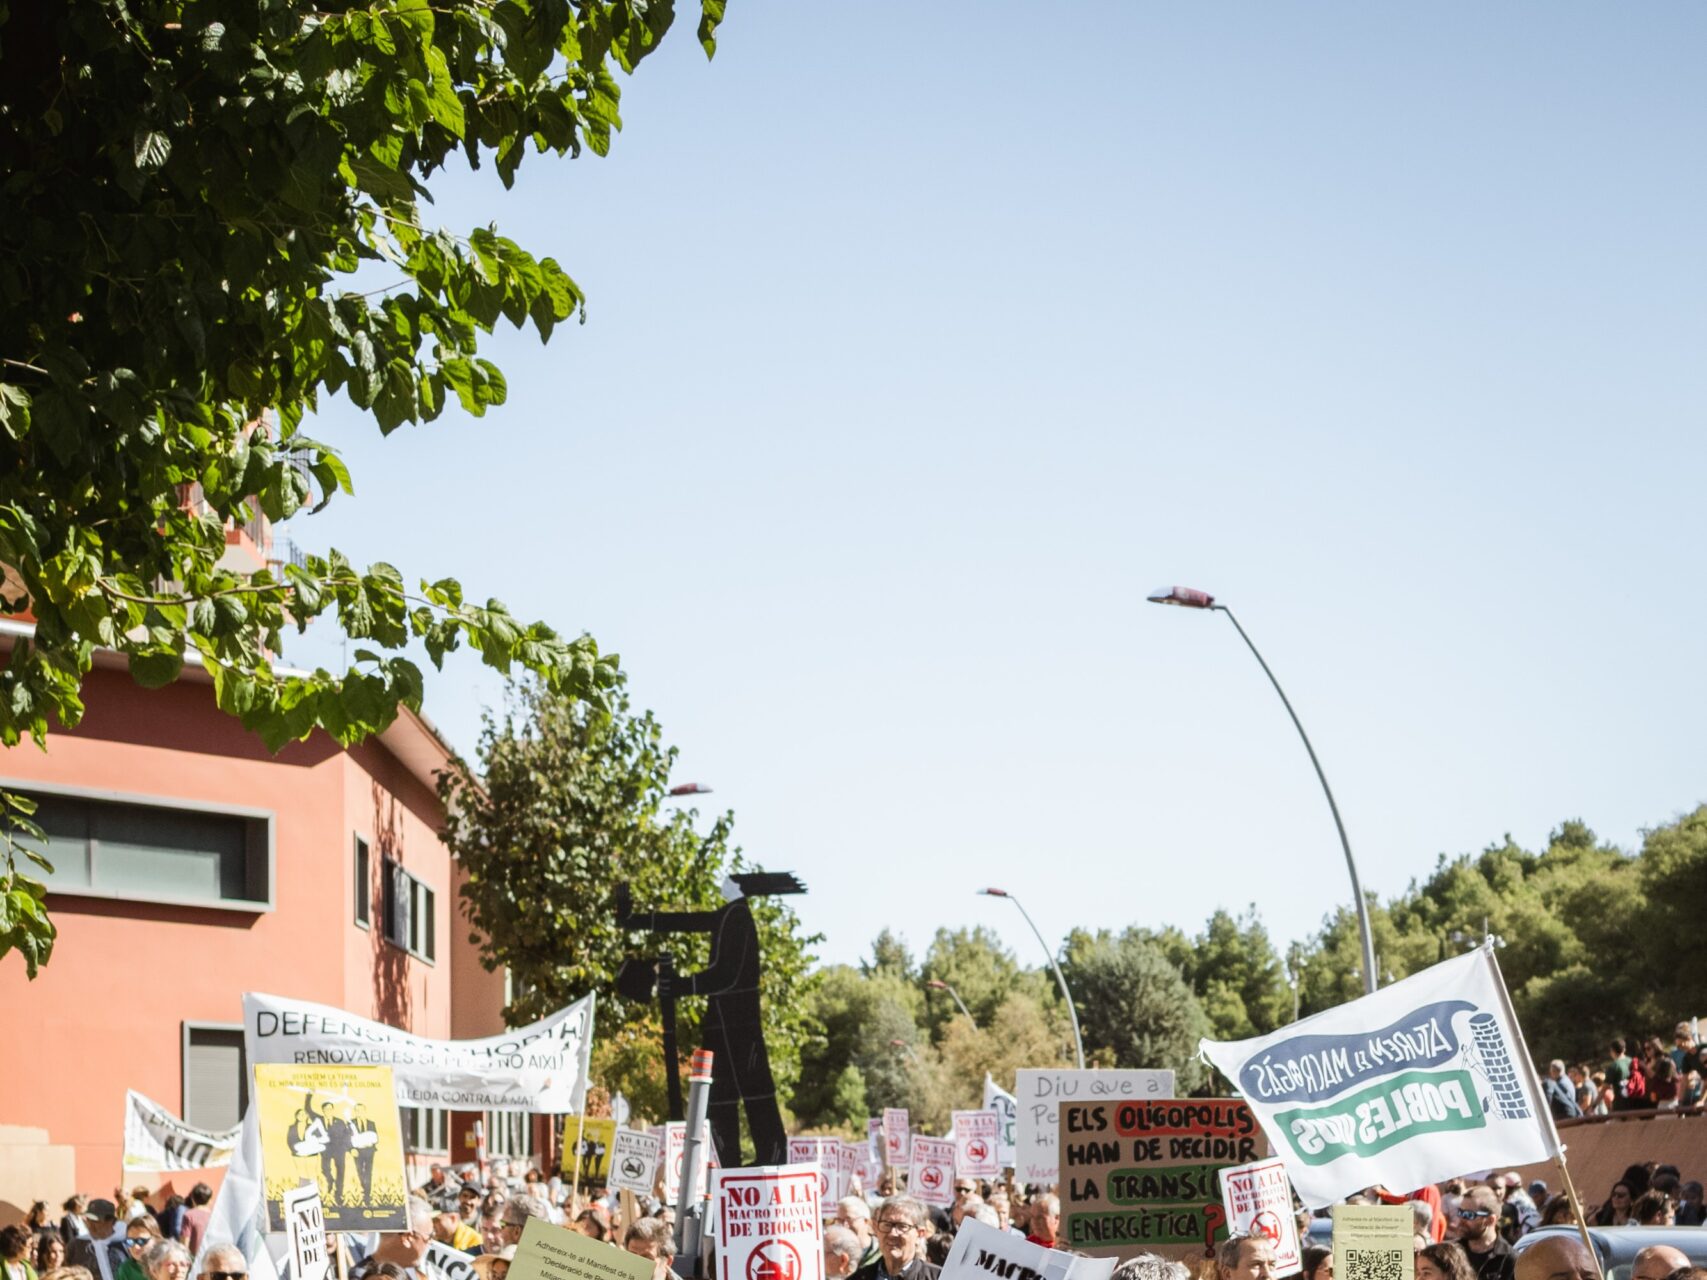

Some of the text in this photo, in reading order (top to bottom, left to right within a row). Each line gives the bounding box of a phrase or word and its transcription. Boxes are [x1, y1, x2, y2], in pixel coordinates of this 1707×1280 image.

[294, 1049, 413, 1064] RENOVABLES
[499, 1053, 524, 1069] NO
[442, 1091, 491, 1105] CONTRA
[1030, 1104, 1059, 1126] Pe
[1067, 1107, 1107, 1132] ELS
[1067, 1141, 1120, 1166] HAN
[1134, 1138, 1163, 1162] DE
[1070, 1178, 1099, 1201] LA
[1232, 1171, 1283, 1193] NO A LA
[727, 1184, 812, 1207] NO A LA
[298, 1206, 320, 1231] NO
[728, 1207, 813, 1220] MACRO PLANTA
[1236, 1202, 1251, 1214] DE
[301, 1231, 322, 1246] MAC
[730, 1219, 813, 1237] DE BIOGAS
[536, 1240, 576, 1259] Adhereix-te
[578, 1255, 585, 1263] al
[586, 1258, 617, 1275] Manifest
[618, 1270, 626, 1279] de
[583, 1271, 593, 1280] de
